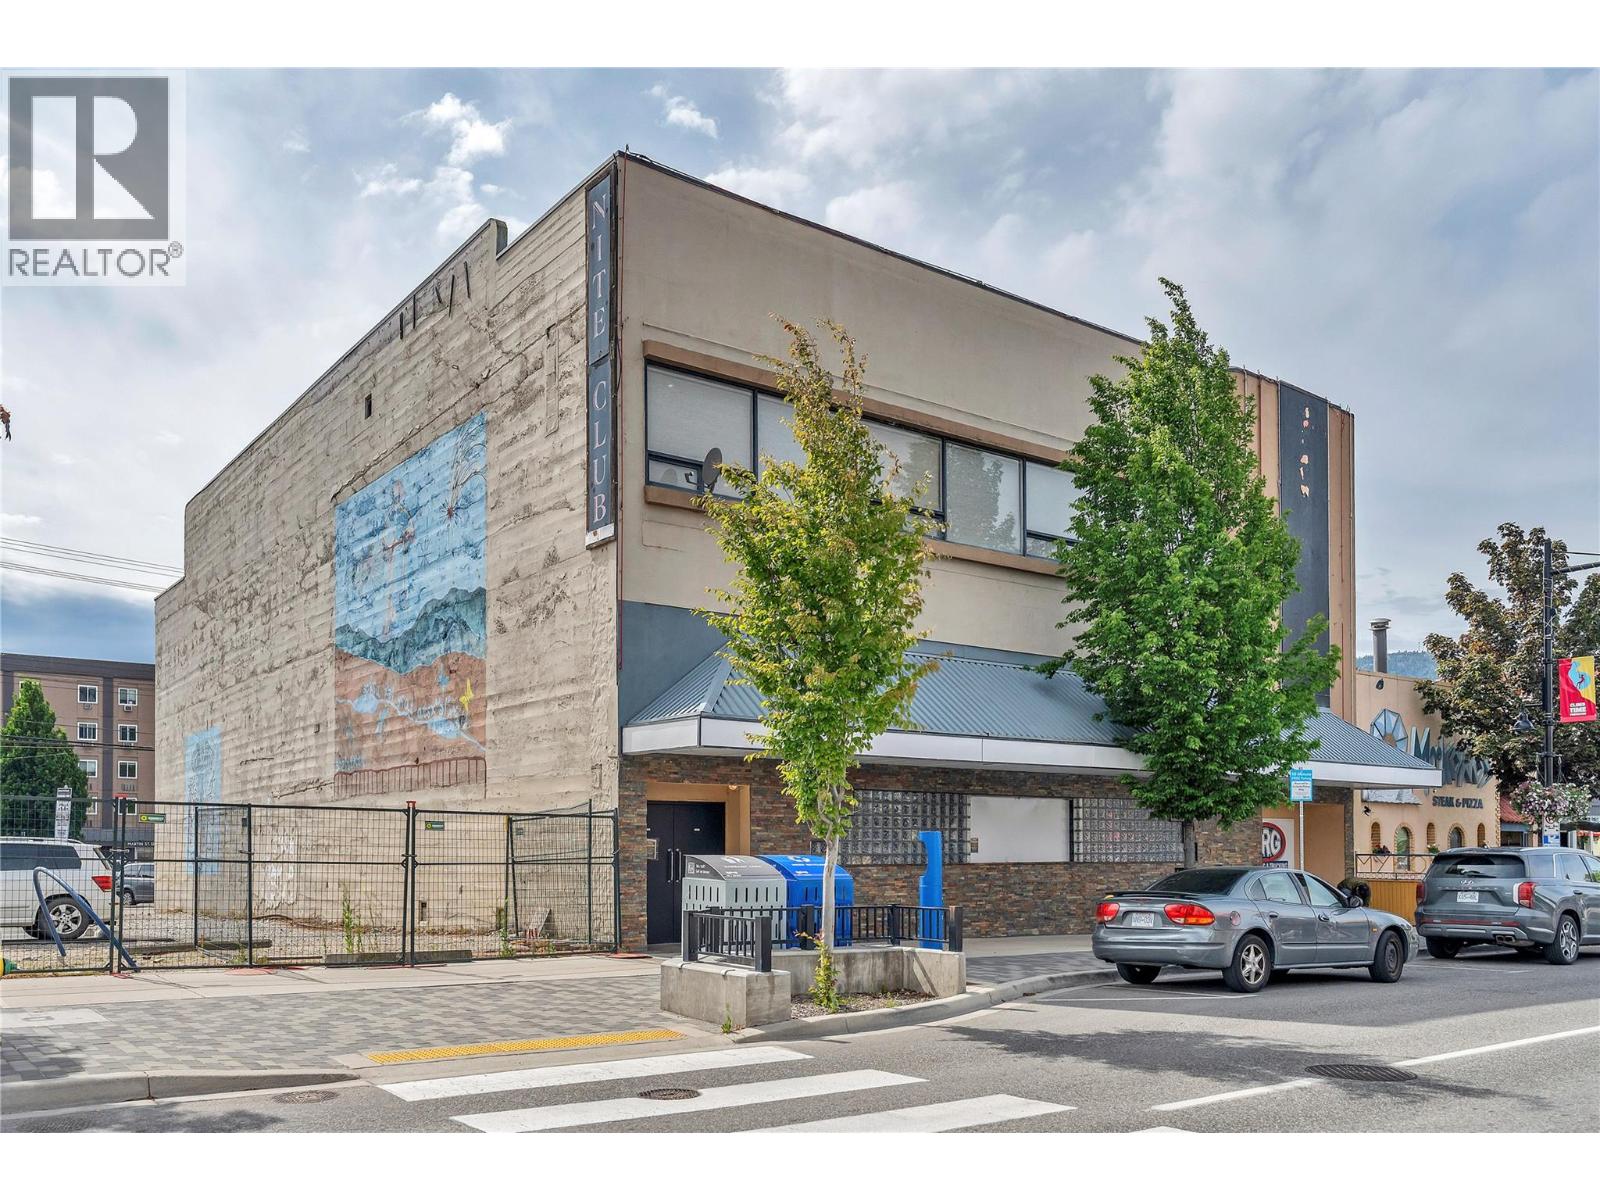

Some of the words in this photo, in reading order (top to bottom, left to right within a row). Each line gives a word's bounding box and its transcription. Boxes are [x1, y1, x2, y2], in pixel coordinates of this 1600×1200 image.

[591, 194, 608, 340] NITE
[592, 380, 608, 524] CLUB
[1432, 795, 1454, 807] STEAK
[1455, 798, 1462, 808] &
[1462, 797, 1484, 809] PIZZA
